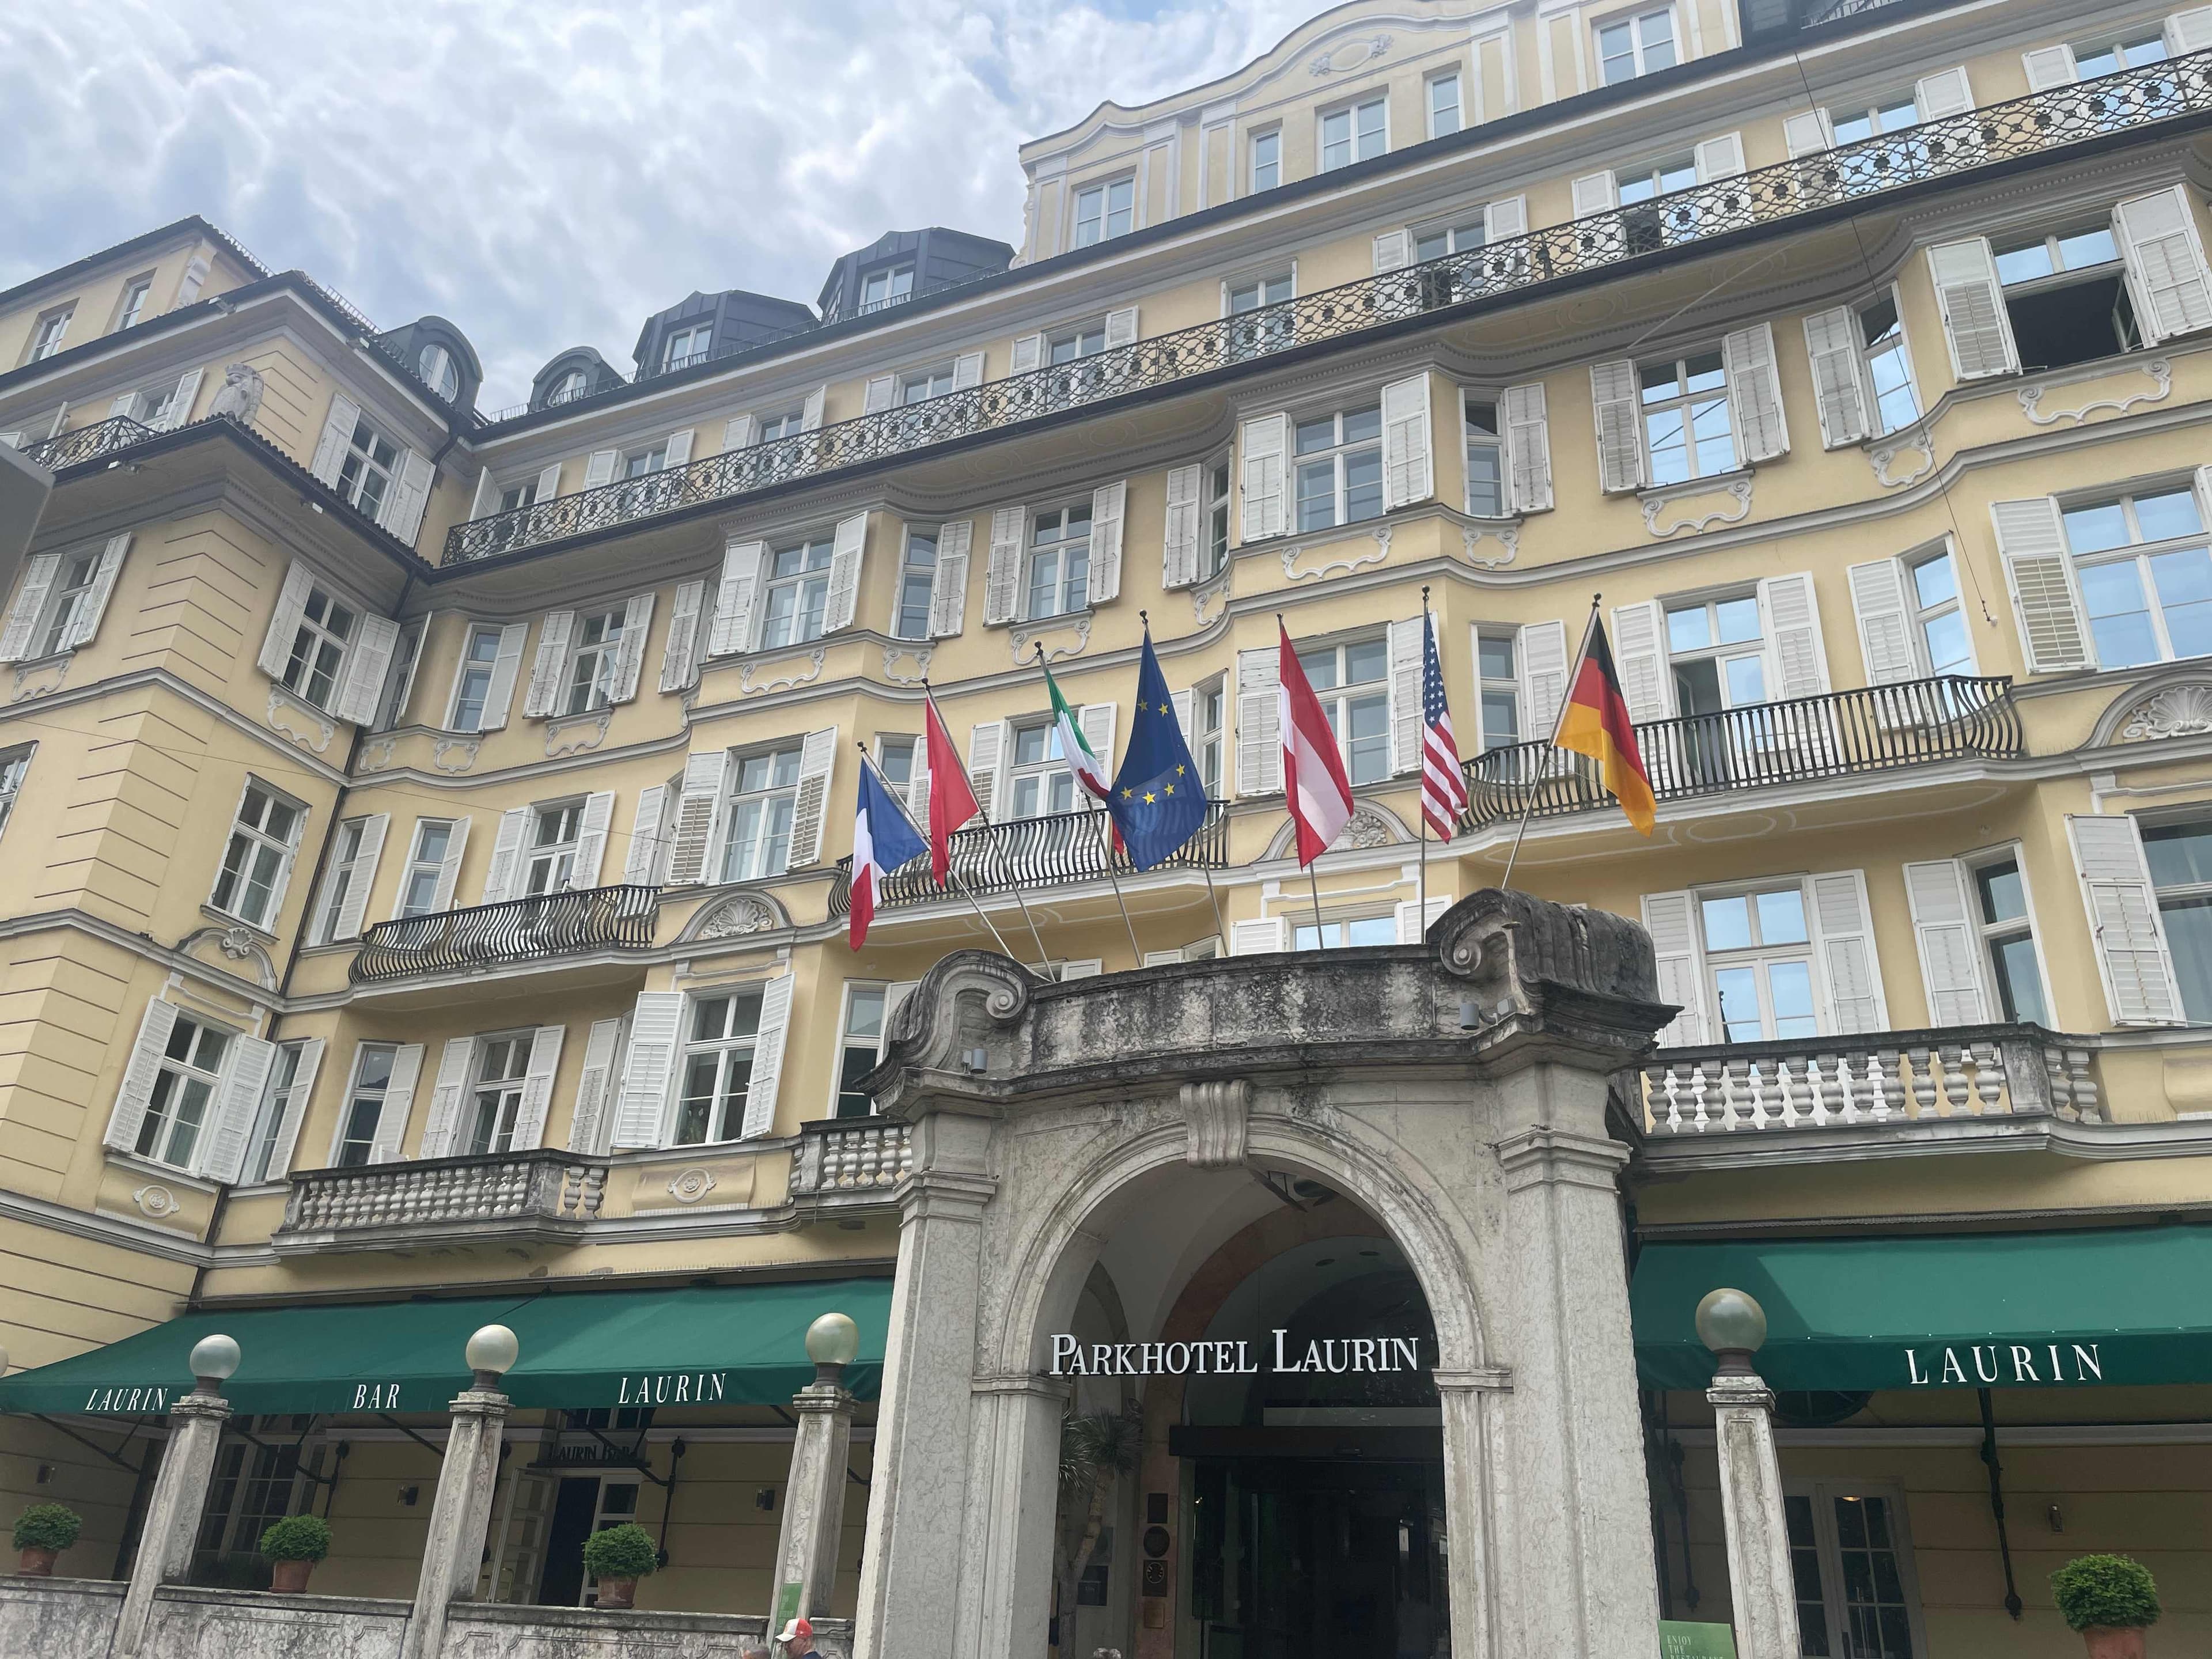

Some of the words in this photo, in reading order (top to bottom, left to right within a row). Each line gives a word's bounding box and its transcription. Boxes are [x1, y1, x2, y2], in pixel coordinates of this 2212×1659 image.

[1049, 1333, 1258, 1376] PARKHOTEL
[1271, 1329, 1419, 1373] LAURIN
[1904, 1344, 2103, 1384] LAURIN
[85, 1388, 168, 1411] LAURIN
[353, 1384, 400, 1408] BAR
[618, 1373, 727, 1404] LAURIN
[1668, 1645, 1685, 1654] THE
